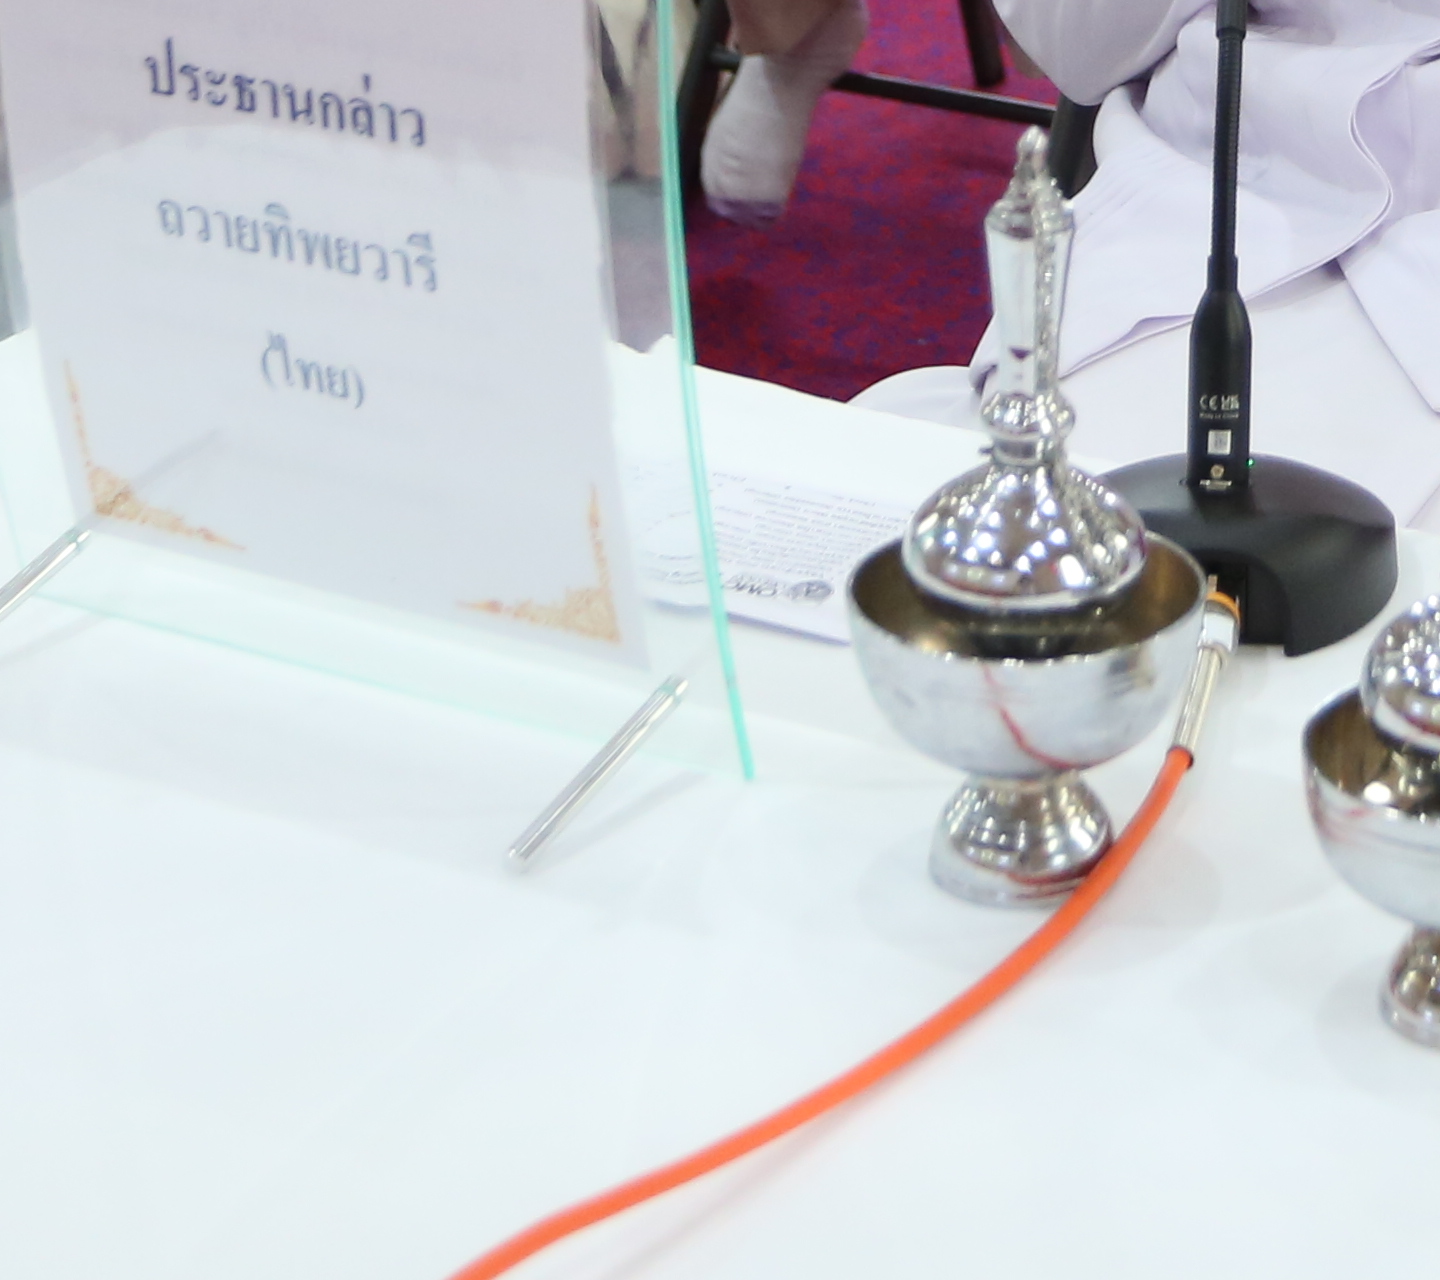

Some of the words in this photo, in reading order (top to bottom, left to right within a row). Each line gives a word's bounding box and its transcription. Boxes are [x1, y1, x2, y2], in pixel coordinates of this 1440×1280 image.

[144, 37, 426, 148] ประธานกล่าว
[157, 199, 437, 292] ถวายทิพยวารี
[261, 329, 365, 409] (ไทย)
